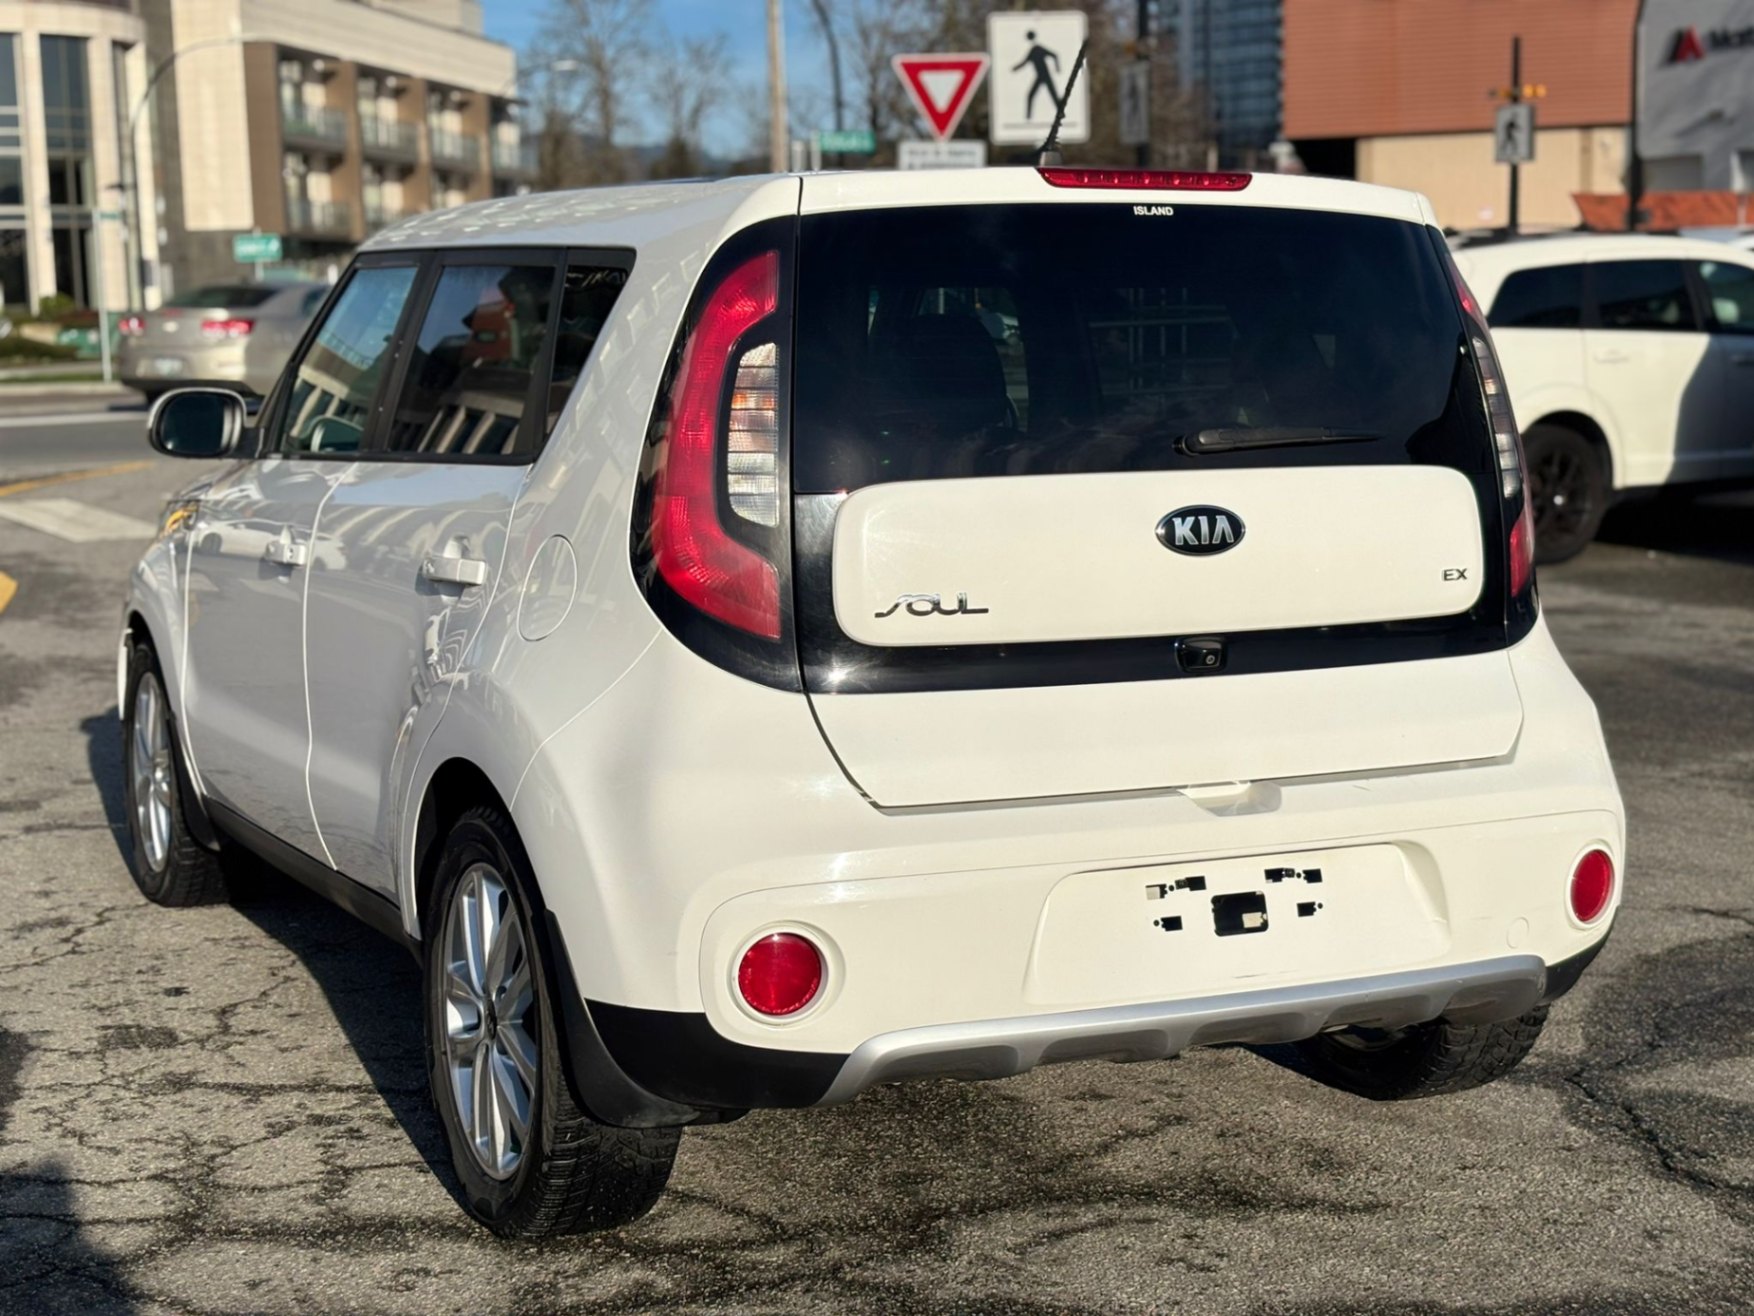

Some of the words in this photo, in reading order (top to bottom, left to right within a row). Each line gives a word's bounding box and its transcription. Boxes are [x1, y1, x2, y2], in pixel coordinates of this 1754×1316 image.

[1133, 205, 1174, 216] ISLAND
[1171, 514, 1235, 546] KIA
[1441, 567, 1468, 581] EX
[874, 592, 989, 619] SOUL
